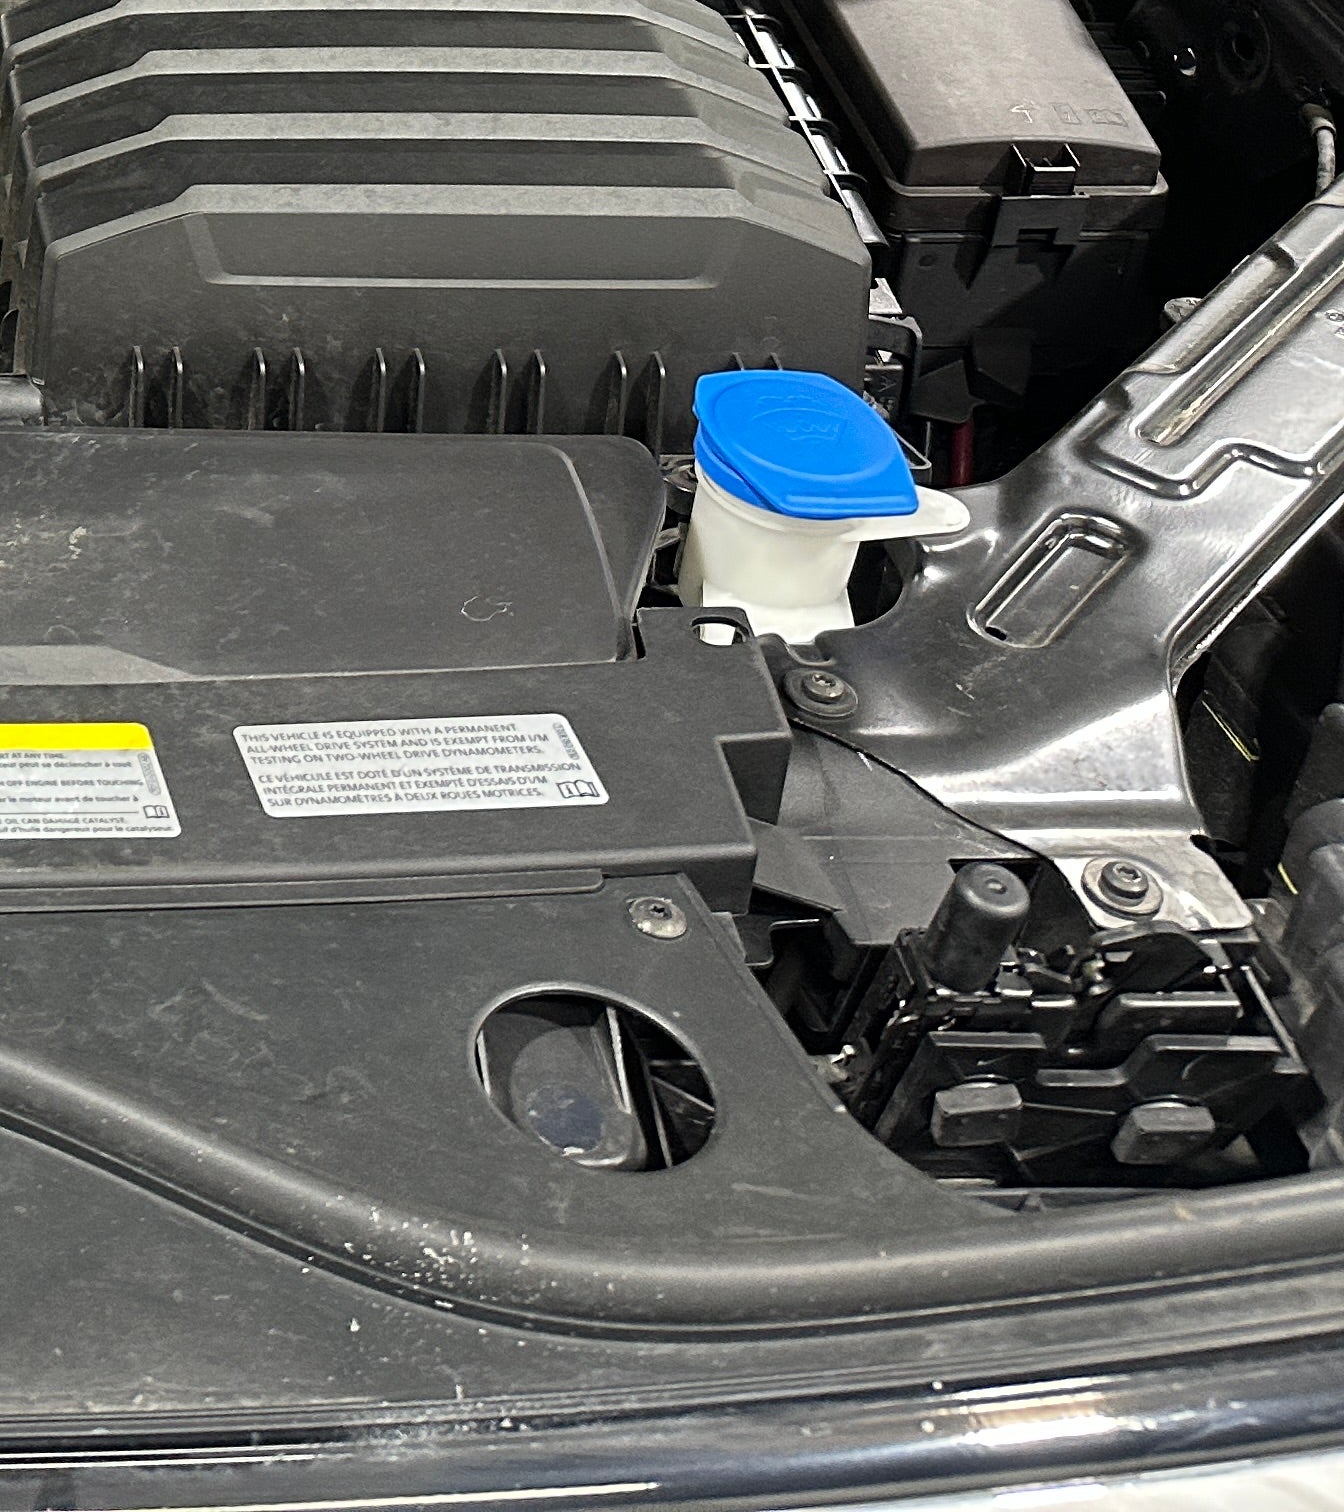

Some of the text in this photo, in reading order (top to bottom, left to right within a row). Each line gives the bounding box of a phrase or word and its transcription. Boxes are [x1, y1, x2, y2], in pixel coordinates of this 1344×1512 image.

[240, 723, 519, 742] THIS VEHICLE IS EQUIPPED WITH A PERMANENT
[244, 733, 550, 753] ALL-WHEEL DRIVE SYSTEM AND IS EXEMPT FROM I/M
[249, 744, 545, 765] TESTING ON TWO-WHEEL DRIVE DYNAMOMETERS.
[256, 761, 582, 783] CE VÉHICULE EST DOTÉ D'UN SYSTÈME DE TRANSMISSION
[260, 783, 326, 795] INTÉGRALE
[325, 781, 398, 792] PERMANENT
[397, 781, 414, 789] ET
[412, 777, 466, 788] EXEMPTÉ
[465, 777, 517, 786] D'ESSAIS
[266, 788, 544, 807] SUR DYNAMOMÈTRES À DEUX ROUES MOTRICES.
